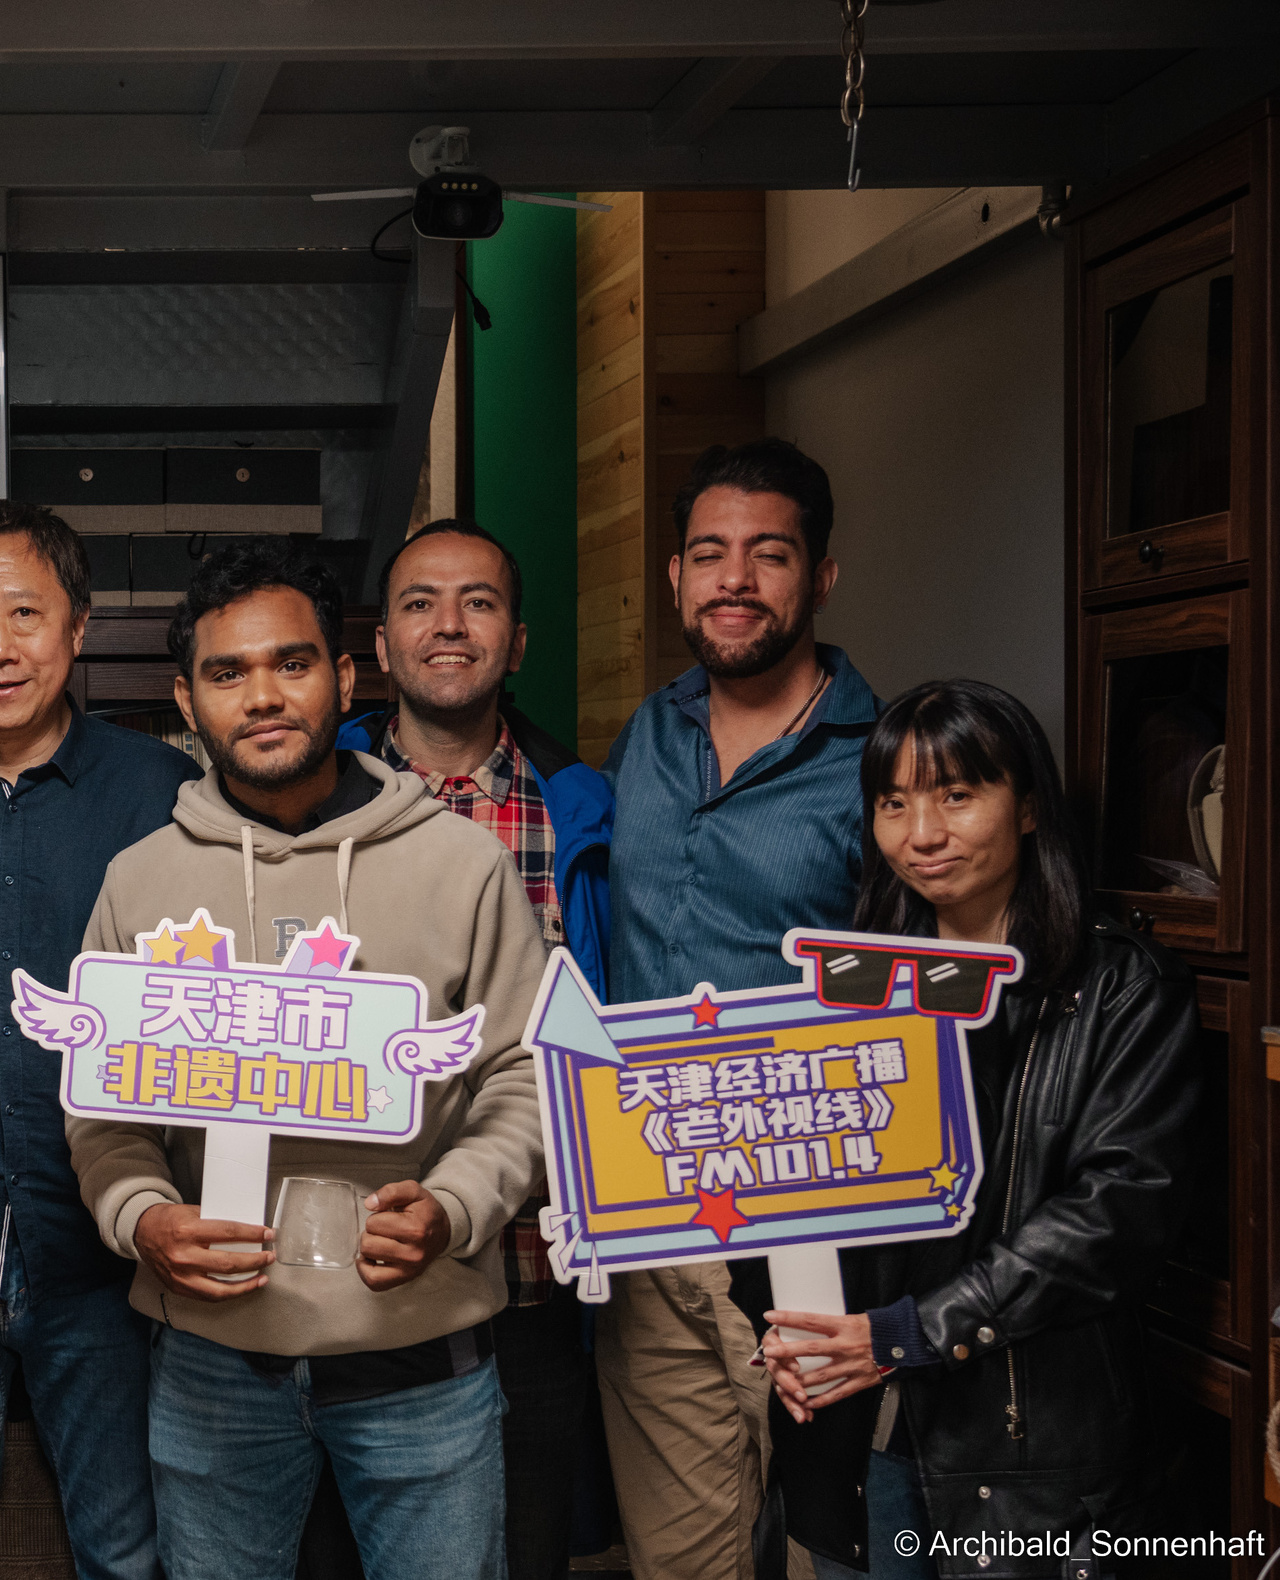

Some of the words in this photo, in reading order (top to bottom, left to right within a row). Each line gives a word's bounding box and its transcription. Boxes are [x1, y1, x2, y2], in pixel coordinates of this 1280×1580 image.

[139, 973, 353, 1051] 天津市
[103, 1041, 370, 1122] 非遗中心
[619, 1038, 908, 1112] 天津经济广播
[641, 1088, 895, 1154] 《老外视线》
[663, 1133, 883, 1196] FM101.4
